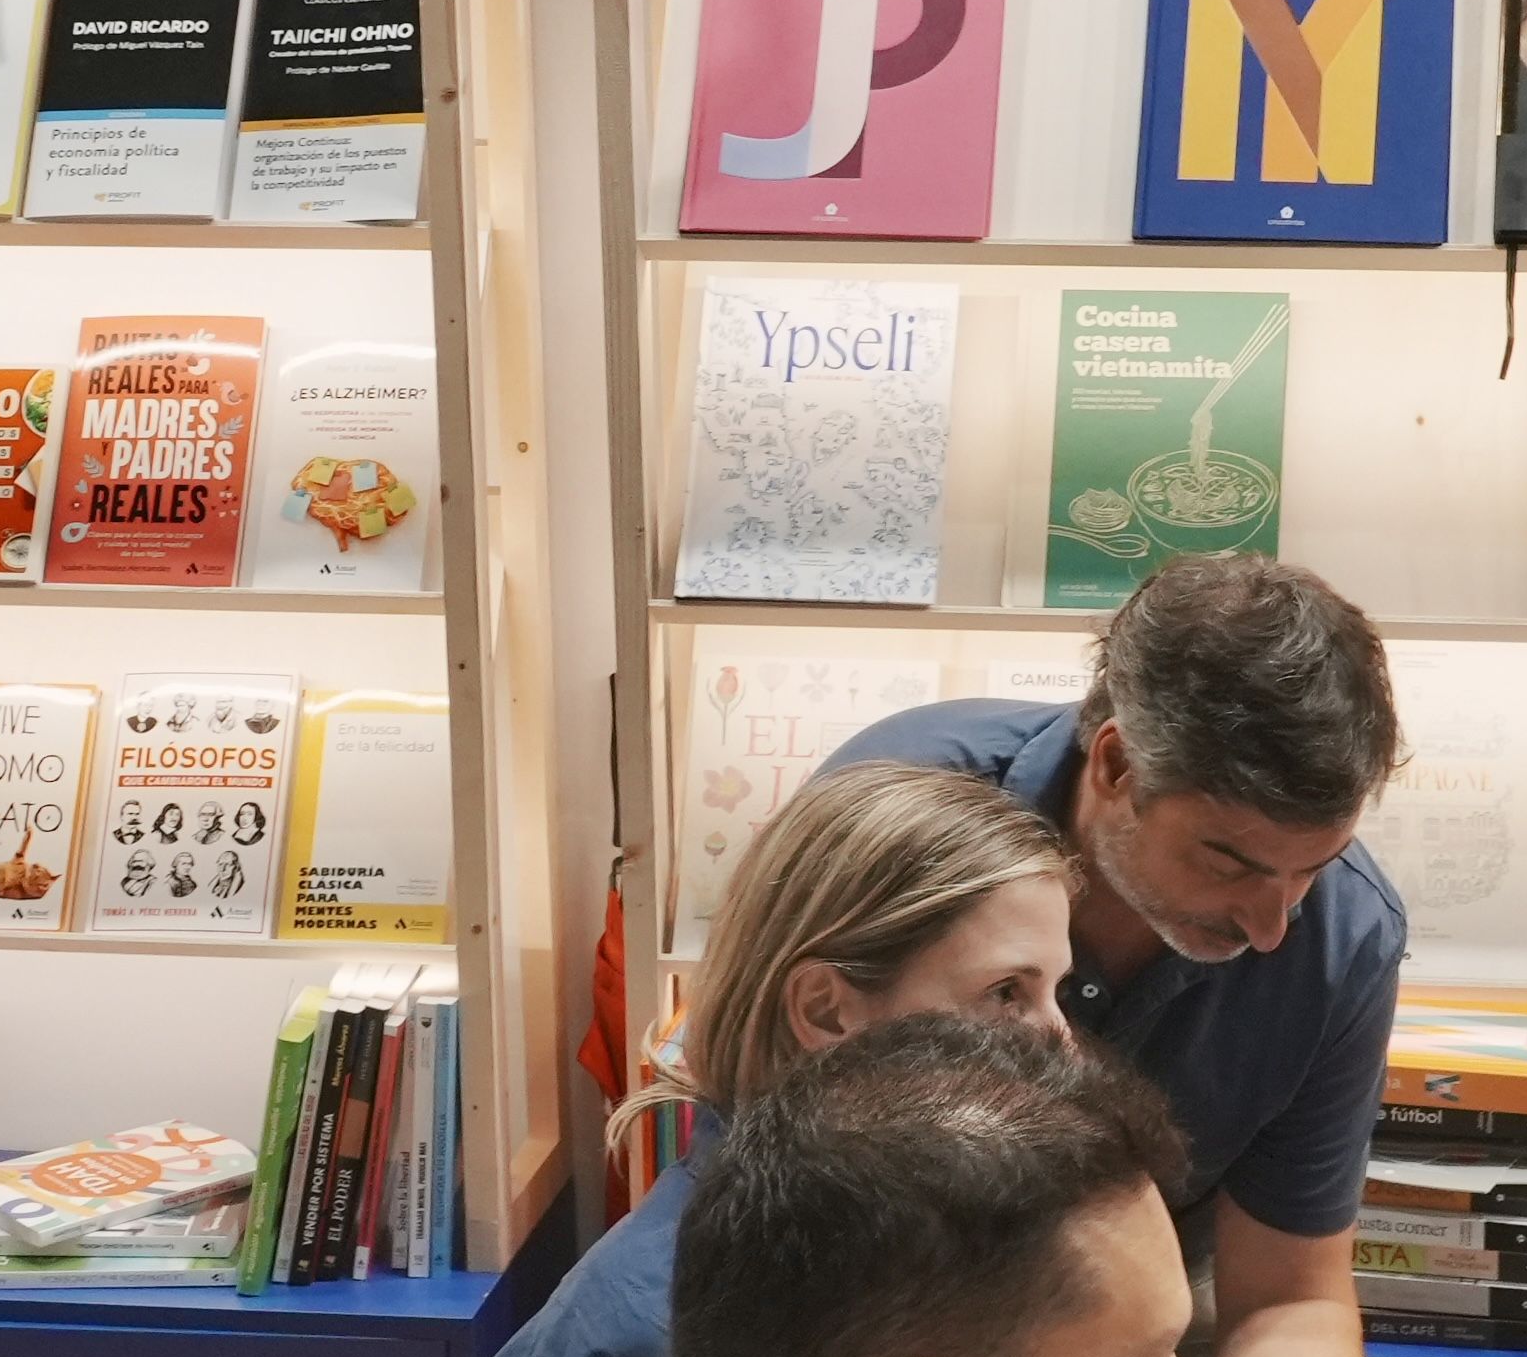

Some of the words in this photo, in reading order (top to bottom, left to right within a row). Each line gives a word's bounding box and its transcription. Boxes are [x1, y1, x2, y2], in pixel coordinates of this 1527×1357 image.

[73, 20, 128, 35] DAVID
[131, 20, 209, 34] RICARDO
[271, 28, 346, 45] TAIICHI
[351, 23, 413, 42] OHNO
[51, 127, 123, 142] Principios
[129, 127, 147, 139] de
[49, 145, 120, 158] economía
[125, 144, 180, 160] política
[46, 167, 53, 181] y
[57, 163, 128, 177] fiscalidad
[1075, 303, 1178, 329] Cocina
[753, 309, 918, 382] Ypseli
[1072, 332, 1170, 354] casera
[1072, 354, 1233, 379] vietnamita
[88, 365, 177, 395] REALES
[81, 398, 219, 440] MADRES
[109, 440, 233, 480] PADRES
[89, 484, 207, 523] REALES
[120, 742, 276, 769] FILÓSOFOS
[295, 906, 352, 915] MENTES
[297, 894, 338, 902] PARA
[294, 920, 376, 928] MODERNAS
[1392, 1107, 1443, 1124] fútbol
[316, 1113, 334, 1164] SISTEMA
[312, 1168, 326, 1193] POR
[332, 1169, 353, 1221] PODER
[302, 1196, 321, 1245] VENDER
[328, 1222, 344, 1241] EL
